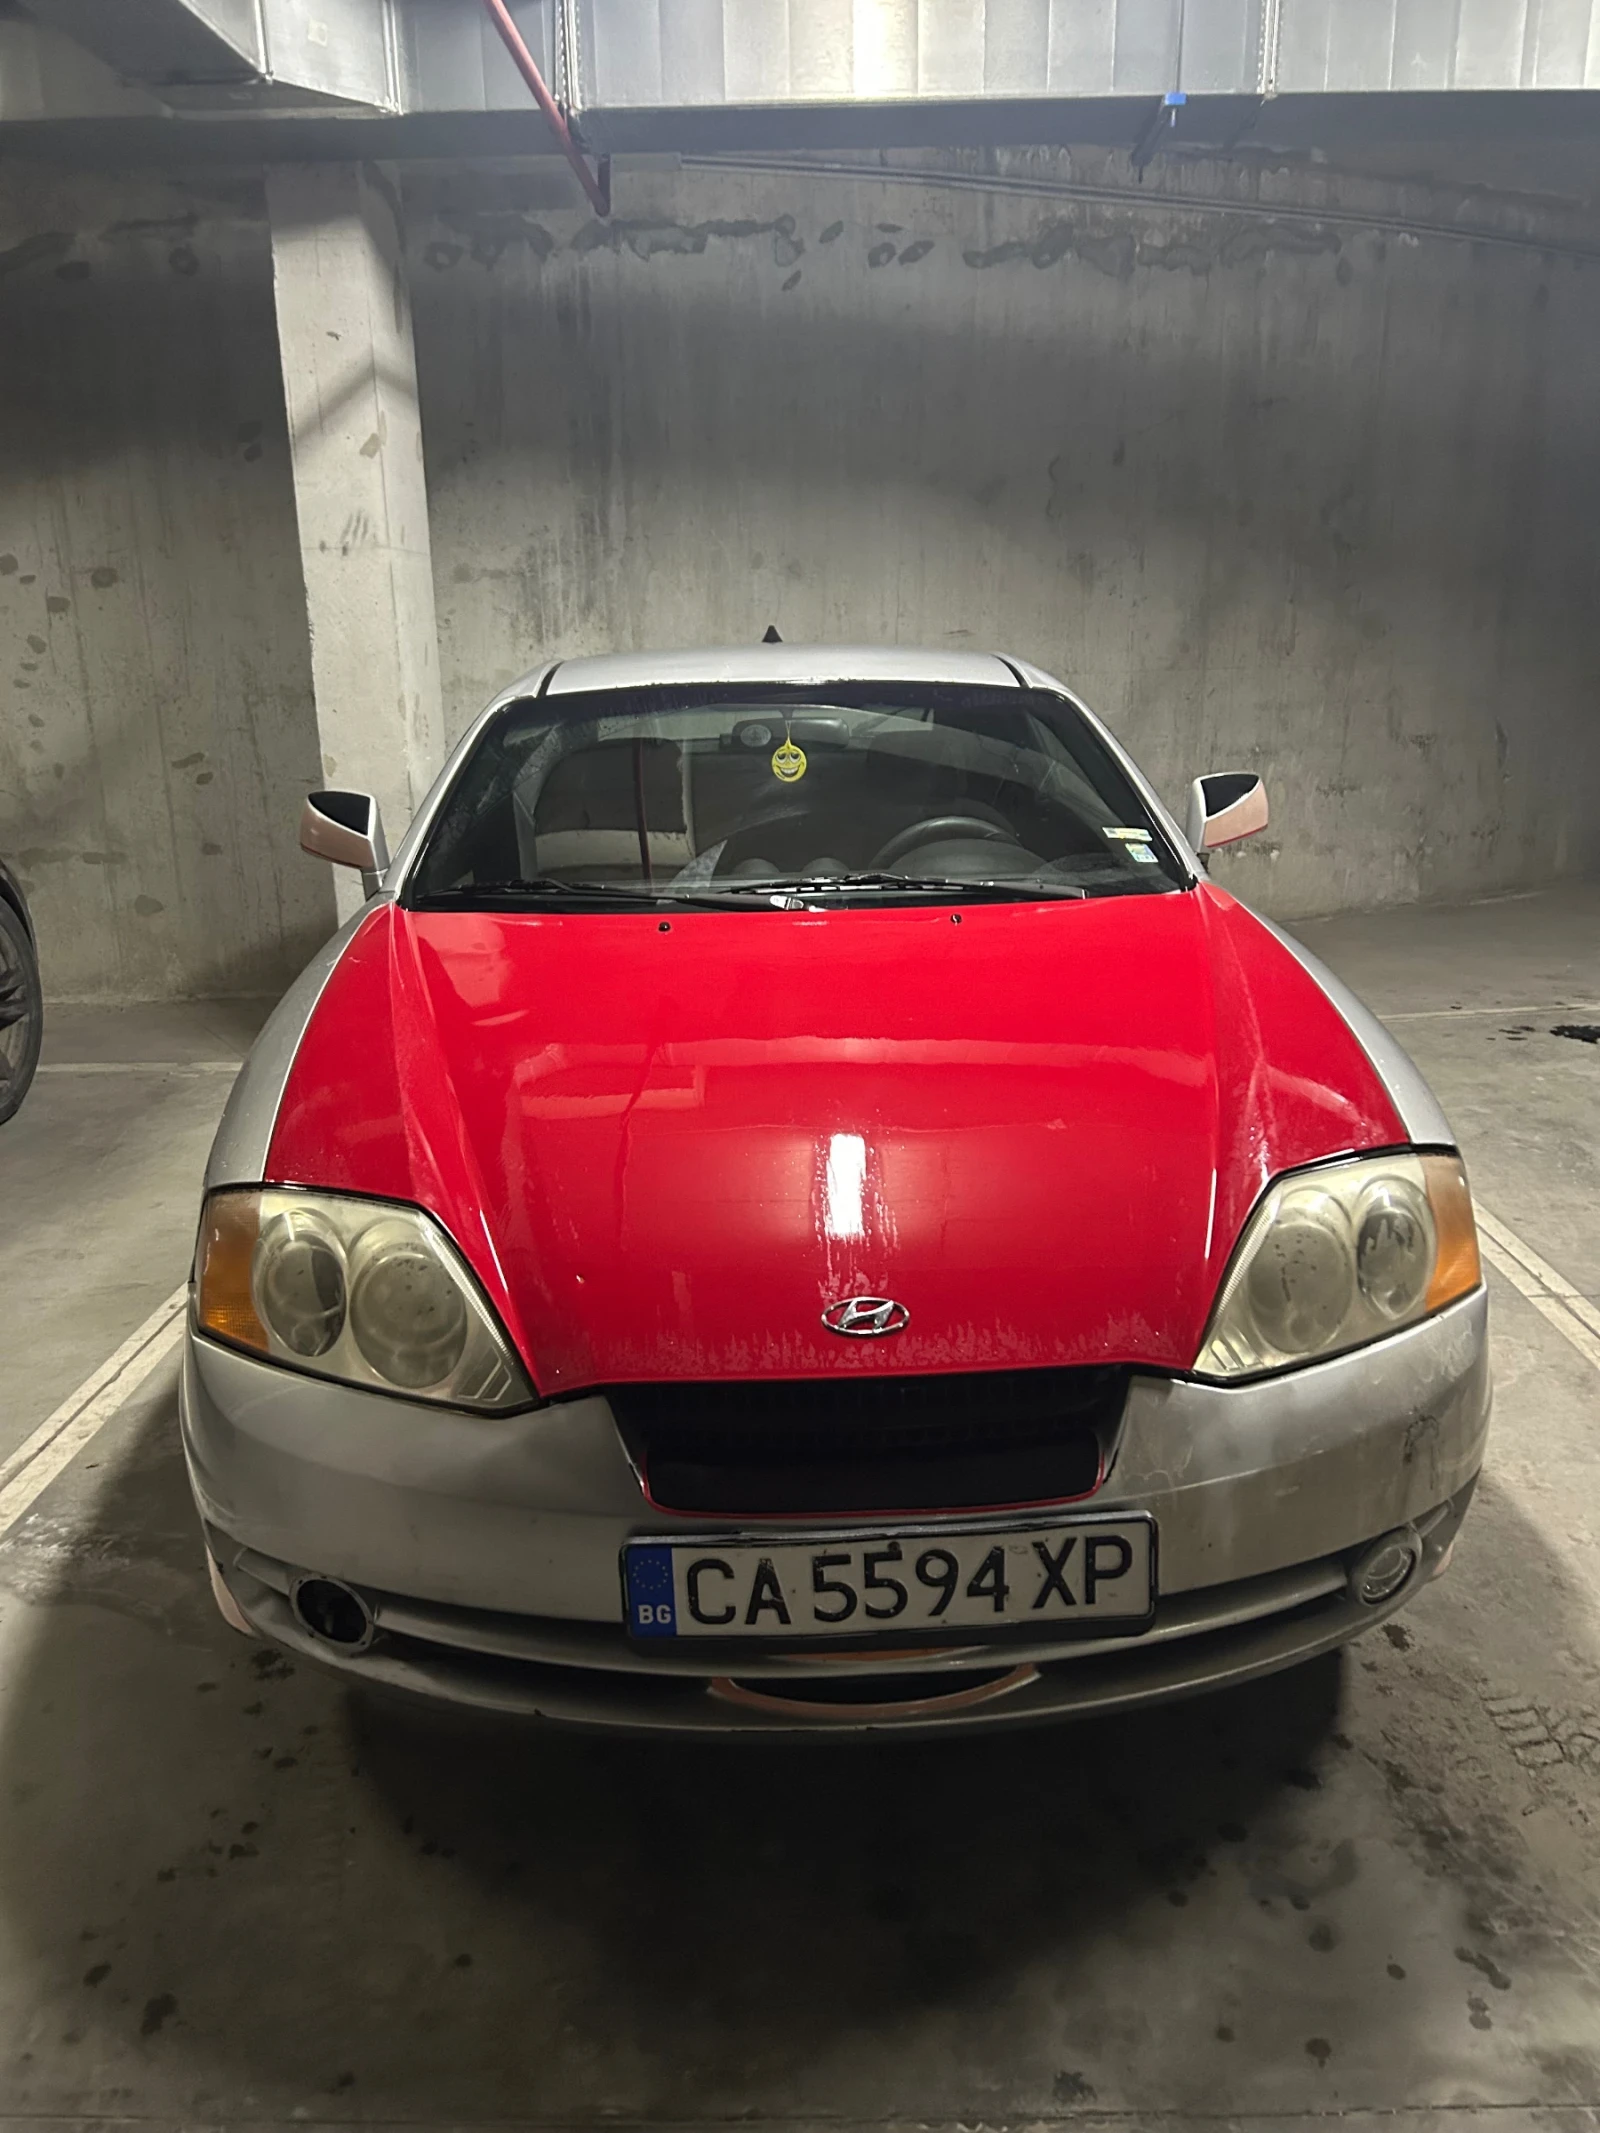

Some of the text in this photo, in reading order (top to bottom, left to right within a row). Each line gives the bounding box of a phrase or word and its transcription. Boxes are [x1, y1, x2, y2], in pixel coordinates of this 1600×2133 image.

[687, 1535, 1133, 1625] CA 5594 XP
[638, 1604, 672, 1625] BG
